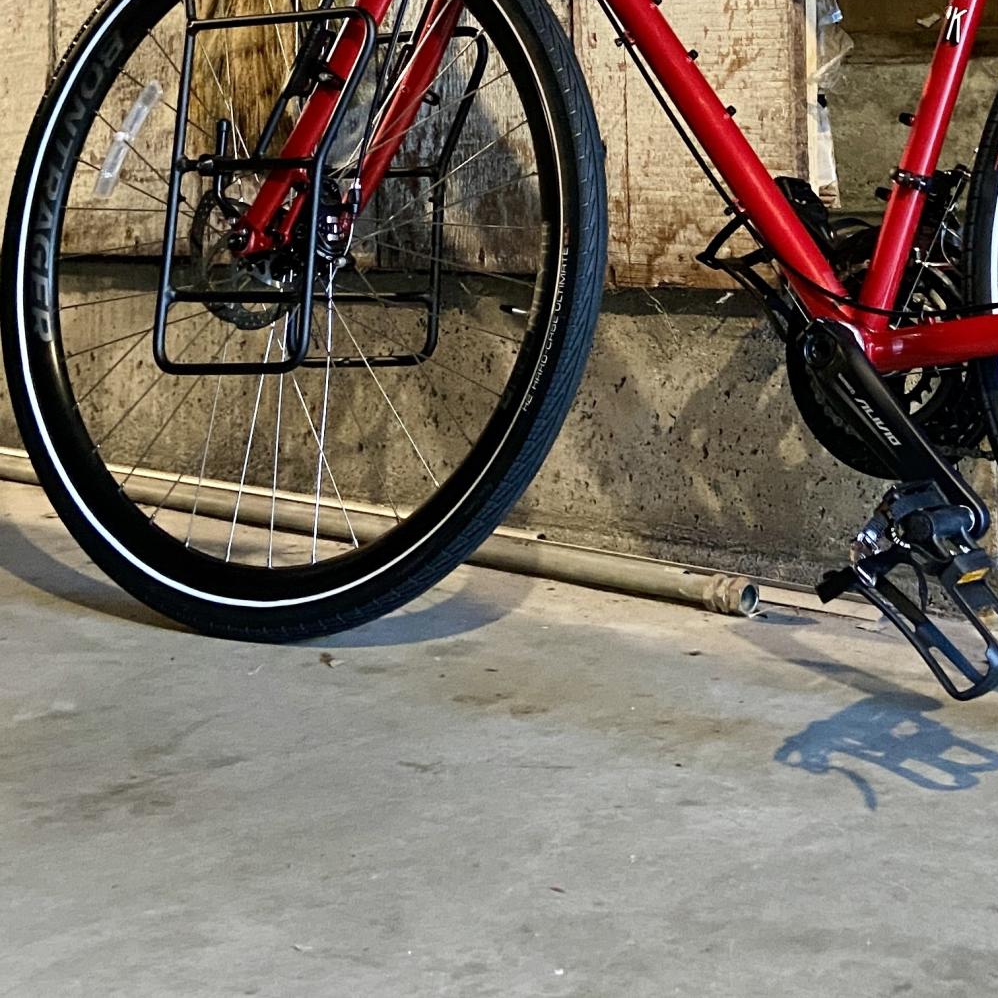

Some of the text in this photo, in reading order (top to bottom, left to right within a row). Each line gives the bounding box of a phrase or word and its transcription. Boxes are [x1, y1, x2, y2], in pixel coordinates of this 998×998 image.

[31, 30, 124, 343] BONTRAGER
[554, 247, 569, 312] ULTIMATE
[854, 397, 902, 446] ALIVIO
